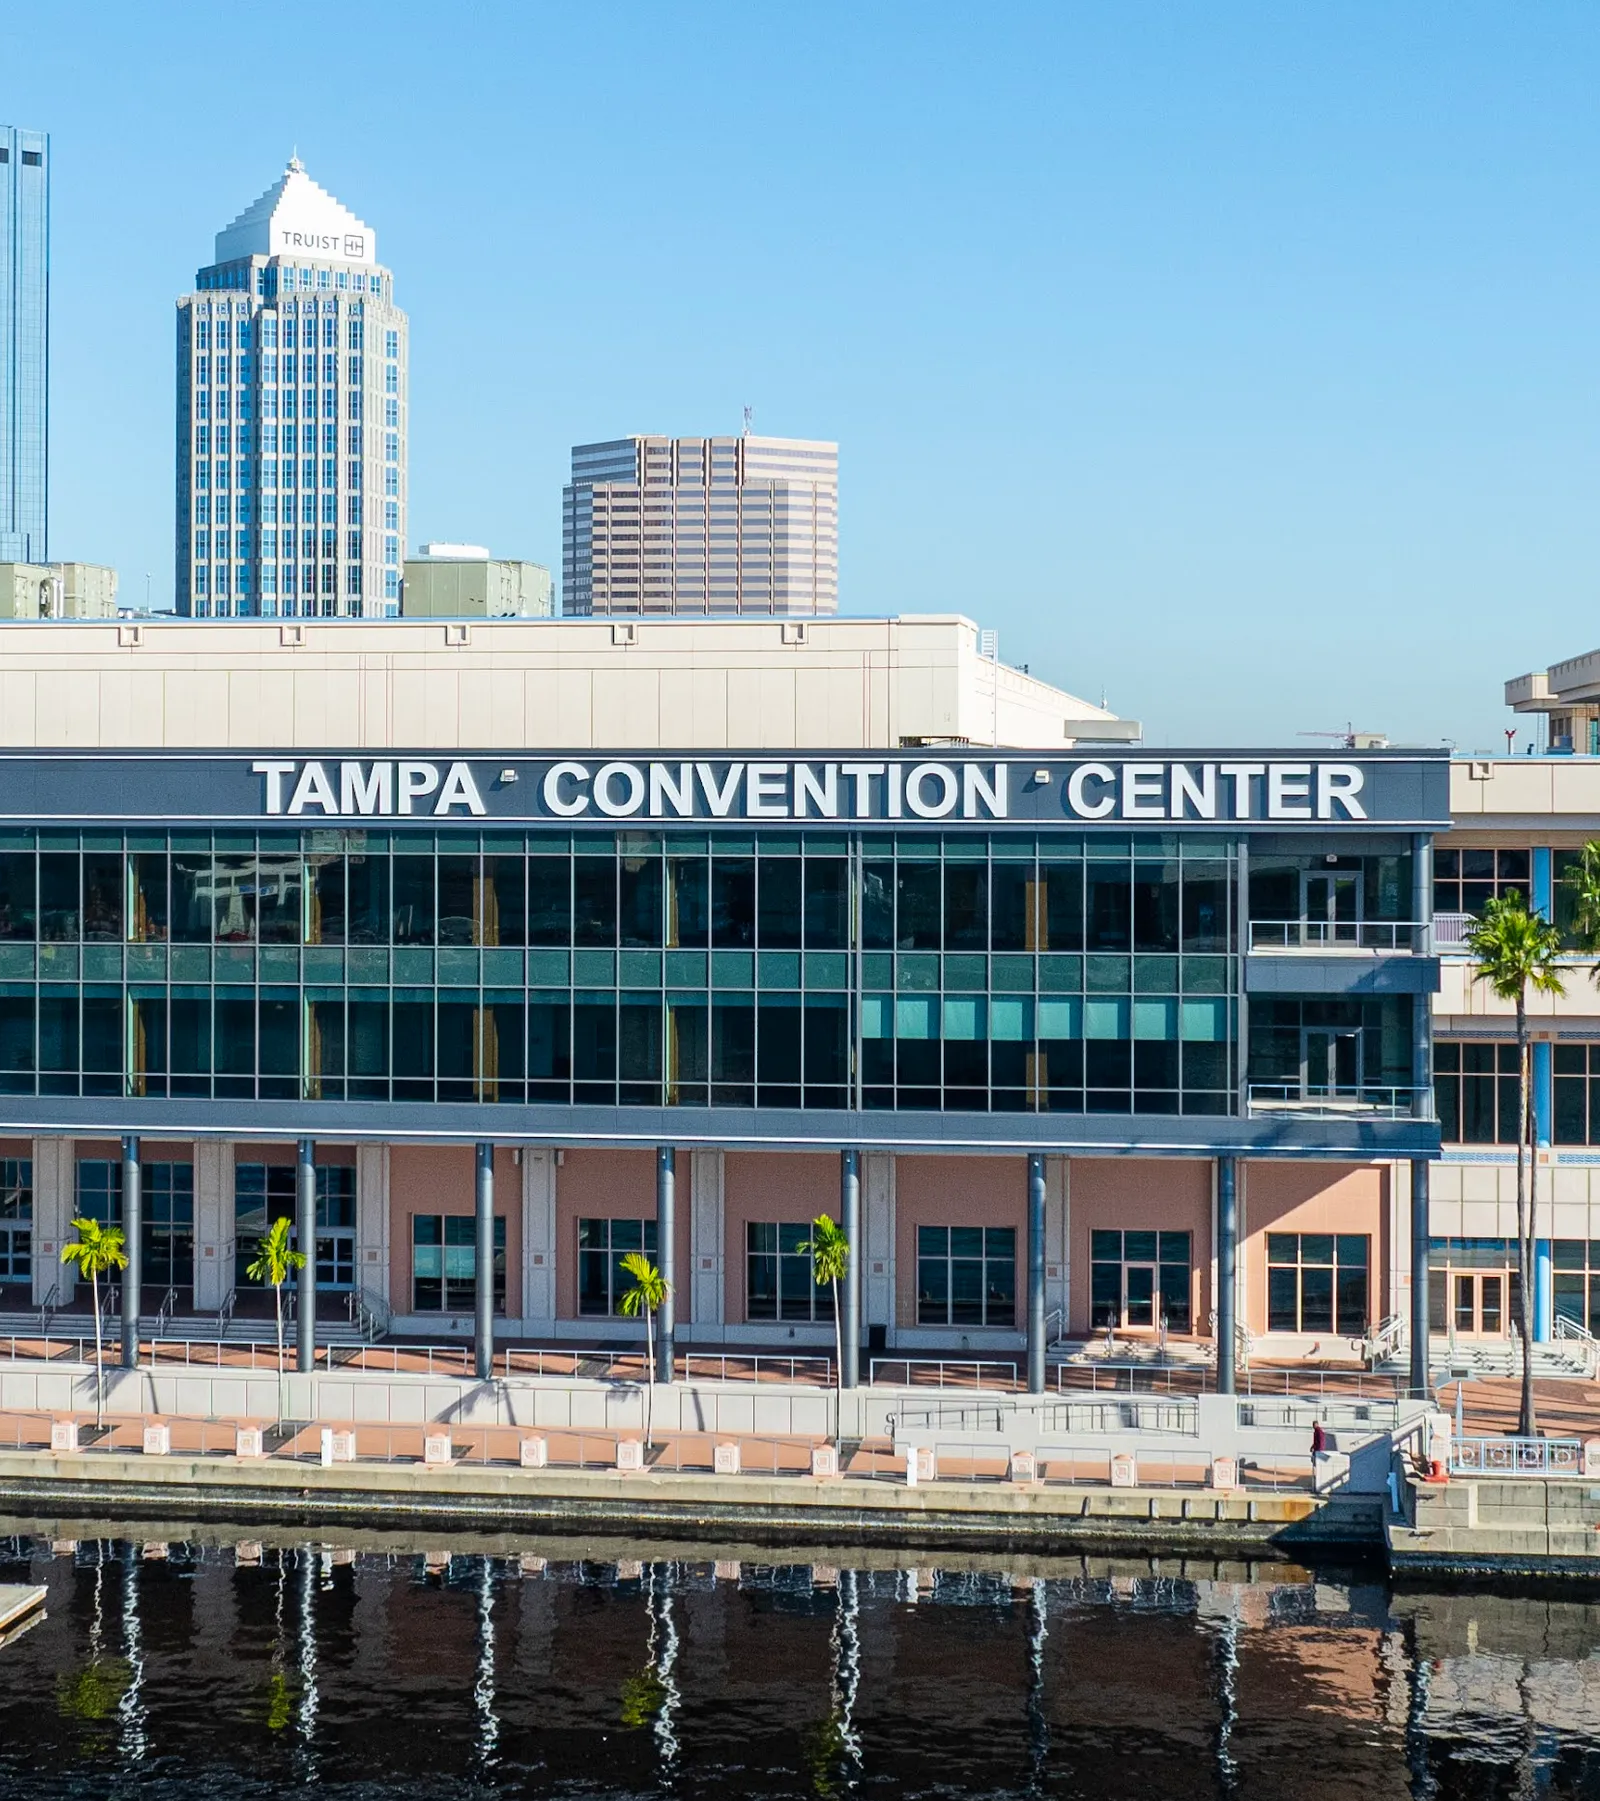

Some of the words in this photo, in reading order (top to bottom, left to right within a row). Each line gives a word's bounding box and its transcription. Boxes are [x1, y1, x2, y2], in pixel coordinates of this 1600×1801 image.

[282, 231, 340, 250] TRUIST
[252, 760, 487, 815] TAMPA
[542, 760, 1008, 818] CONVENTION
[1067, 761, 1368, 819] CENTER
